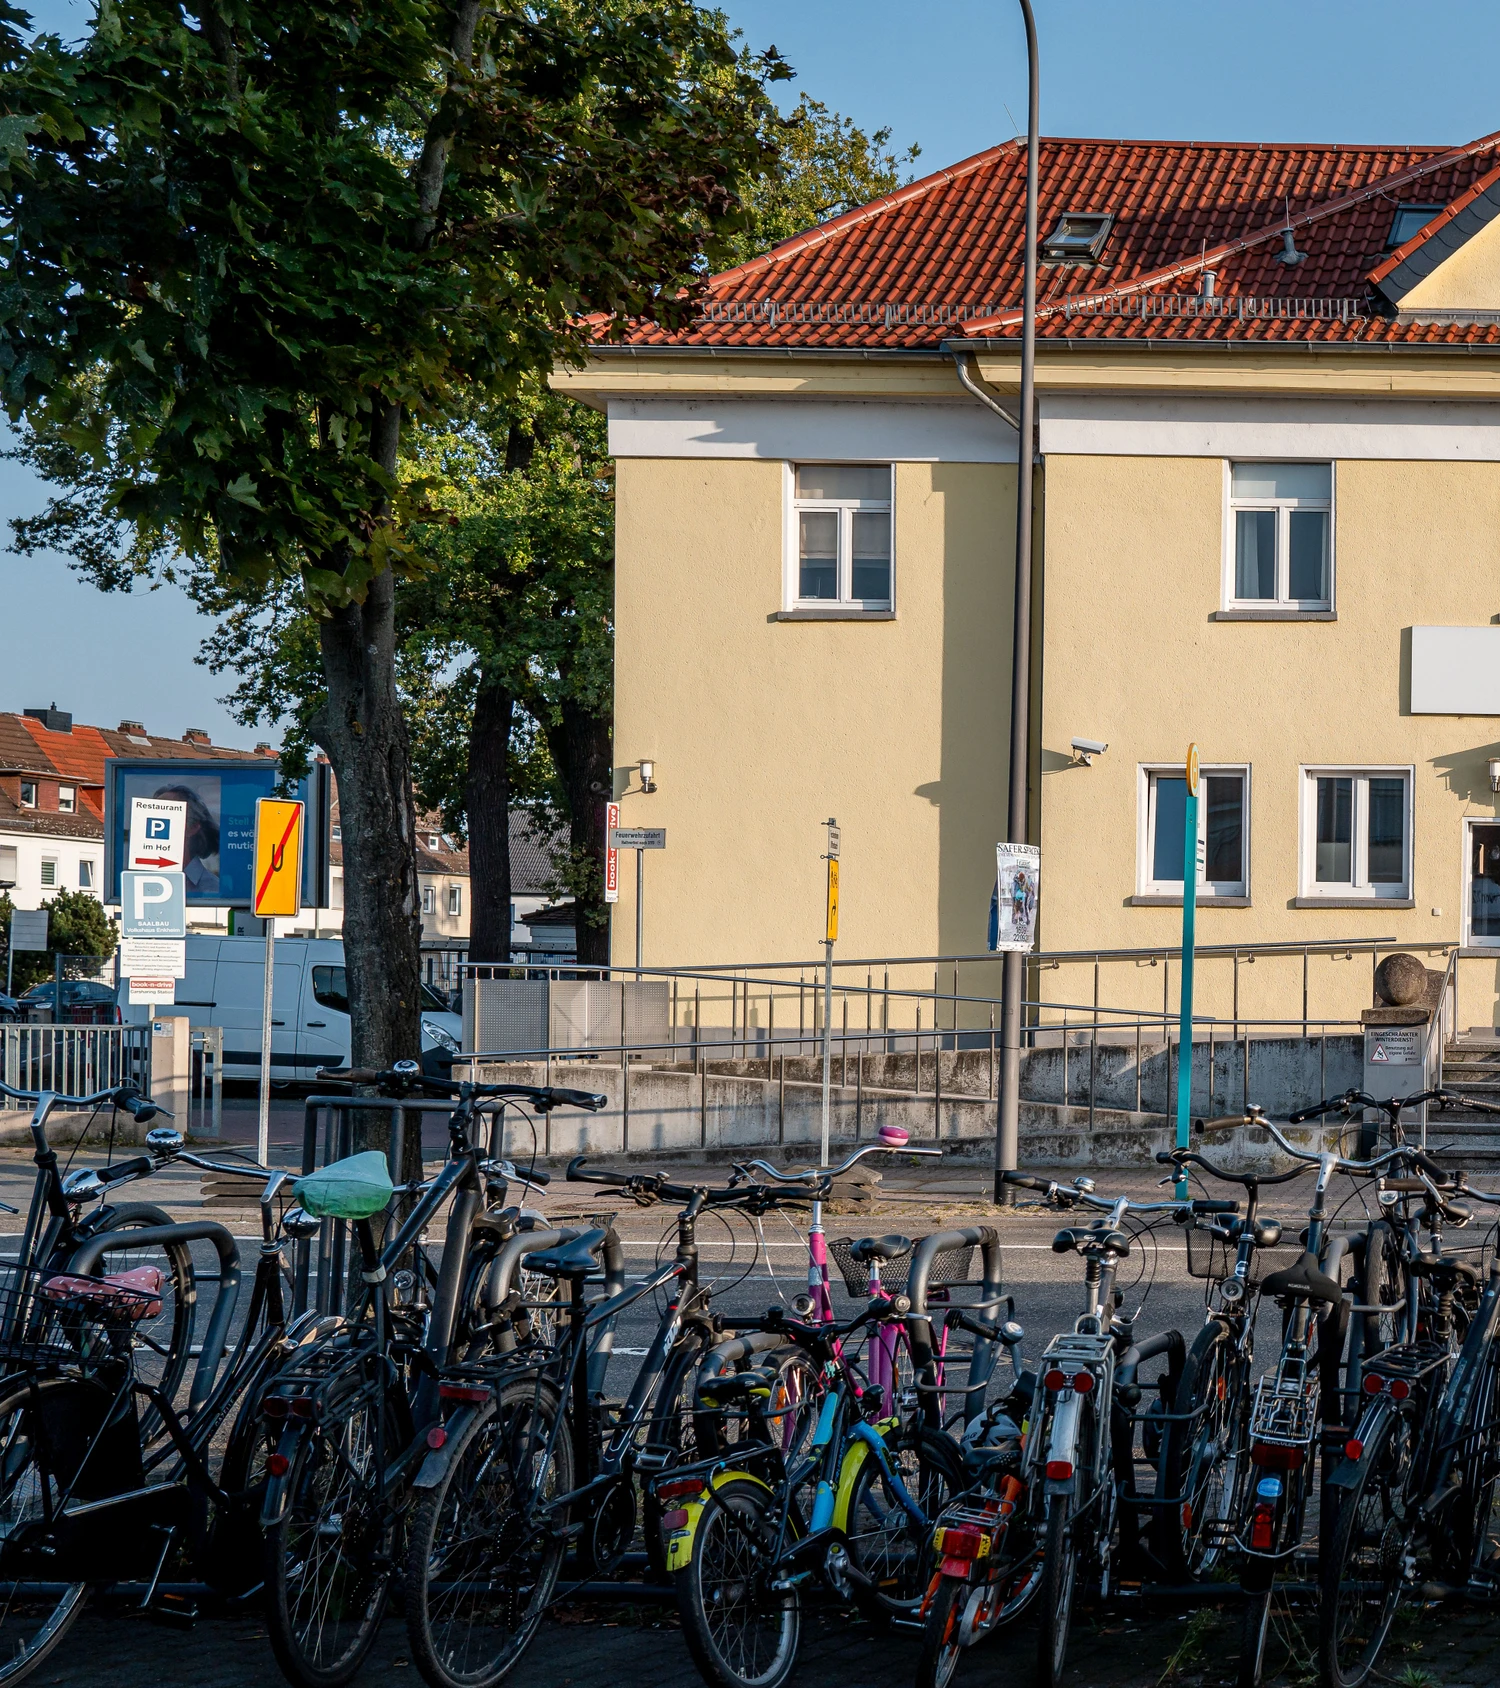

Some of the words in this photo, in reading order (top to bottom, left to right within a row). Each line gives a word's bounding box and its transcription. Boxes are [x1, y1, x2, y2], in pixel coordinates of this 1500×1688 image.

[136, 801, 183, 812] Restaurant
[228, 816, 250, 826] Stell
[150, 820, 166, 837] P
[227, 830, 239, 838] es
[615, 831, 661, 839] Feuerwehrzufahrt
[998, 843, 1023, 854] SAFER
[271, 843, 285, 873] U
[133, 875, 173, 920] P
[1370, 1030, 1419, 1038] EINGESCHRÄNKTER
